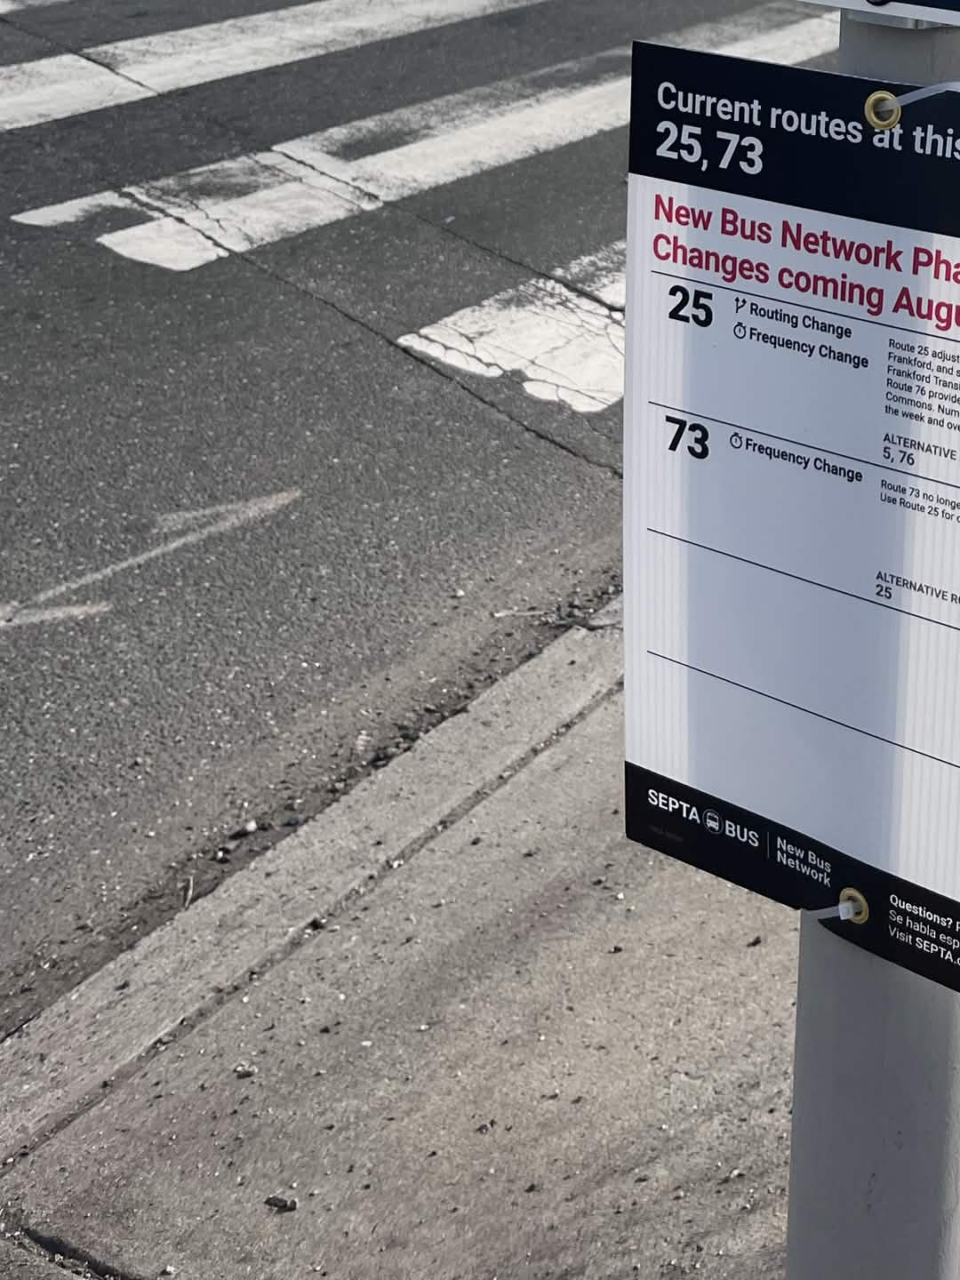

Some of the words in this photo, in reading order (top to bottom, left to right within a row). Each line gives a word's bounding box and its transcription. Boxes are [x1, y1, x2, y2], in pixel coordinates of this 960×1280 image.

[657, 82, 761, 127] Current
[770, 107, 863, 143] routes
[872, 123, 903, 151] at
[654, 194, 712, 231] New
[721, 208, 772, 243] Bus
[781, 221, 903, 272] Network
[653, 233, 769, 283] Changes
[778, 267, 884, 316] coming
[668, 285, 713, 327] 25
[750, 302, 798, 328] Routing
[803, 315, 852, 339] Change
[750, 327, 815, 357] Frequency
[819, 344, 869, 368] Change
[889, 339, 915, 353] Route
[917, 345, 929, 356] 25
[887, 366, 931, 383] Frankford
[888, 352, 934, 371] Frankford,
[937, 362, 954, 375] and
[886, 378, 913, 393] Route
[915, 385, 926, 396] 76
[886, 392, 934, 412] Commons.
[885, 405, 899, 416] the
[901, 408, 925, 421] week
[927, 414, 944, 427] and
[665, 415, 709, 460] 73
[883, 433, 957, 461] ALTERNATIVE
[745, 438, 810, 469] Frequency
[813, 458, 863, 483] Change
[883, 447, 894, 462] 5,
[899, 451, 915, 466] 76
[881, 480, 907, 495] Route
[909, 487, 920, 498] 73
[923, 493, 934, 502] no
[880, 493, 897, 505] Use
[899, 497, 925, 512] Route
[927, 505, 939, 516] 25
[941, 508, 954, 520] for
[875, 584, 892, 599] 25
[876, 571, 948, 601] ALTERNATIVE
[648, 789, 700, 824] SEPTA
[725, 820, 759, 847] BUS
[777, 836, 805, 857] New
[808, 850, 832, 873] Bus
[777, 851, 831, 887] Network
[889, 909, 903, 924] Se
[906, 916, 936, 939] habla
[890, 894, 953, 927] Questions?
[889, 926, 913, 945] Visit
